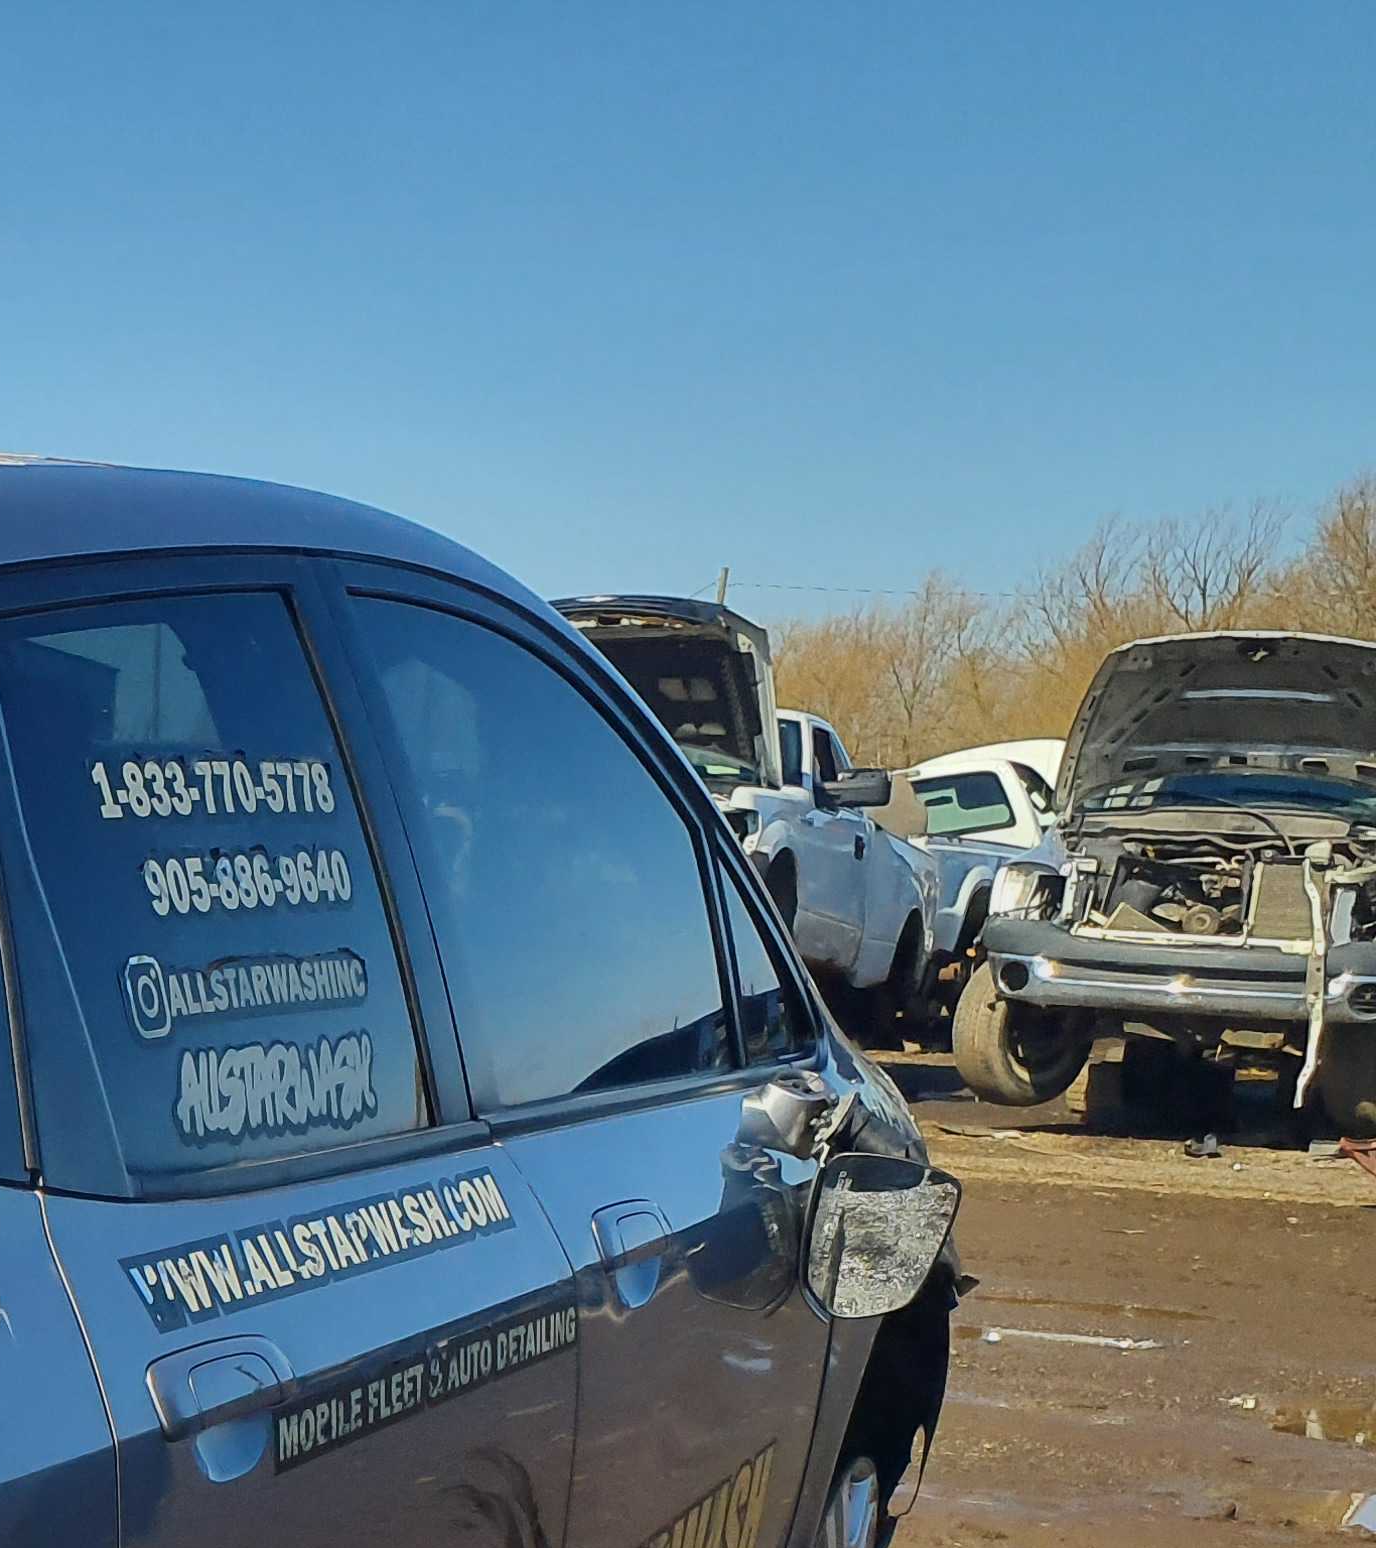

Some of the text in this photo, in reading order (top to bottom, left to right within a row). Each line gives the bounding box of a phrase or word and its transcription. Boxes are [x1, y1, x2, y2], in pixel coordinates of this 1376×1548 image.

[90, 758, 336, 819] 1-833-770-5778
[167, 958, 367, 1018] ALLSTARWASHINC
[447, 1339, 492, 1392] AUTO
[497, 1306, 577, 1372] DETAILING
